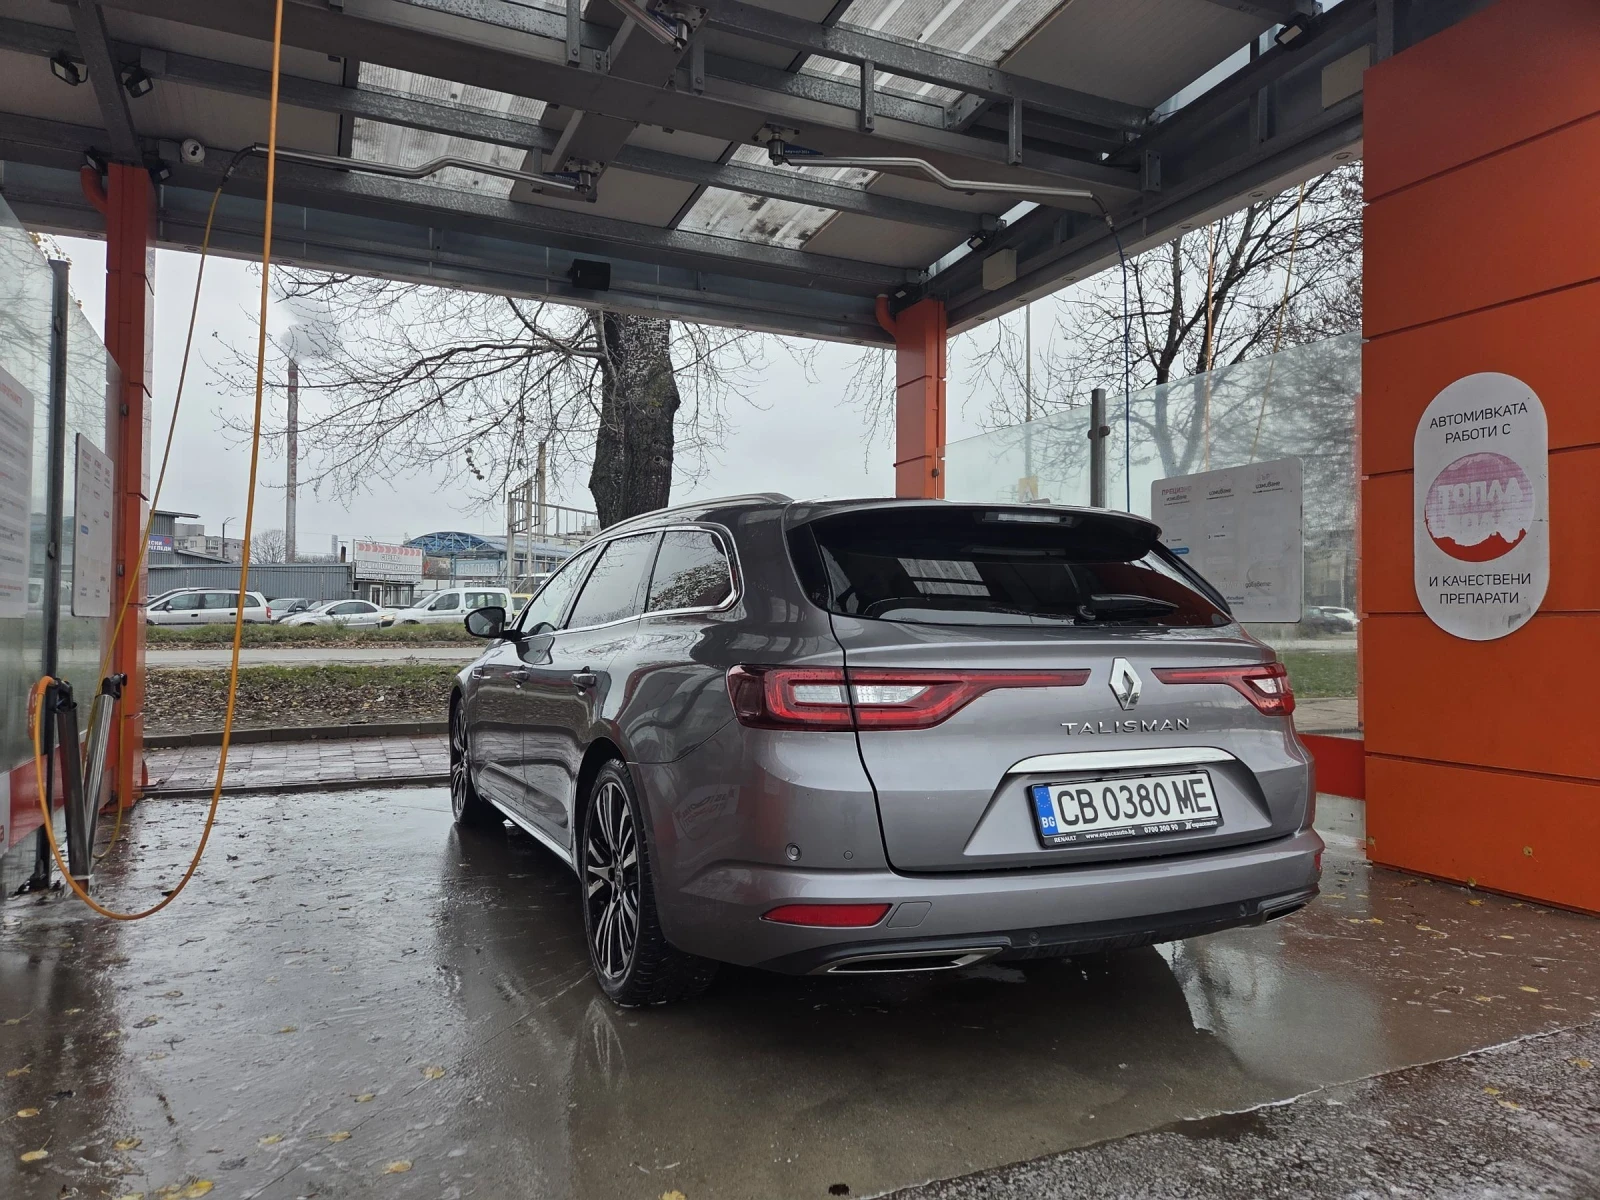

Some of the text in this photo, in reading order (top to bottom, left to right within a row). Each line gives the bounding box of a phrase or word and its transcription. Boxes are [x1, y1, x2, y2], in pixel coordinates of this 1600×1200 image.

[1429, 402, 1528, 429] АВТОМИВКАТА
[1445, 423, 1511, 444] РАБОТИ С
[459, 563, 495, 574] АВТОГАЗ
[1429, 573, 1531, 587] И КАЧЕСТВЕНИ
[1439, 592, 1519, 605] ПРЕПАРАТИ
[1061, 718, 1190, 736] TALISMAN
[1057, 778, 1213, 827] CB 0380 ME
[1041, 816, 1056, 829] BG
[1054, 835, 1077, 843] RENAULT
[1085, 828, 1136, 840] www.espaceauto.bg
